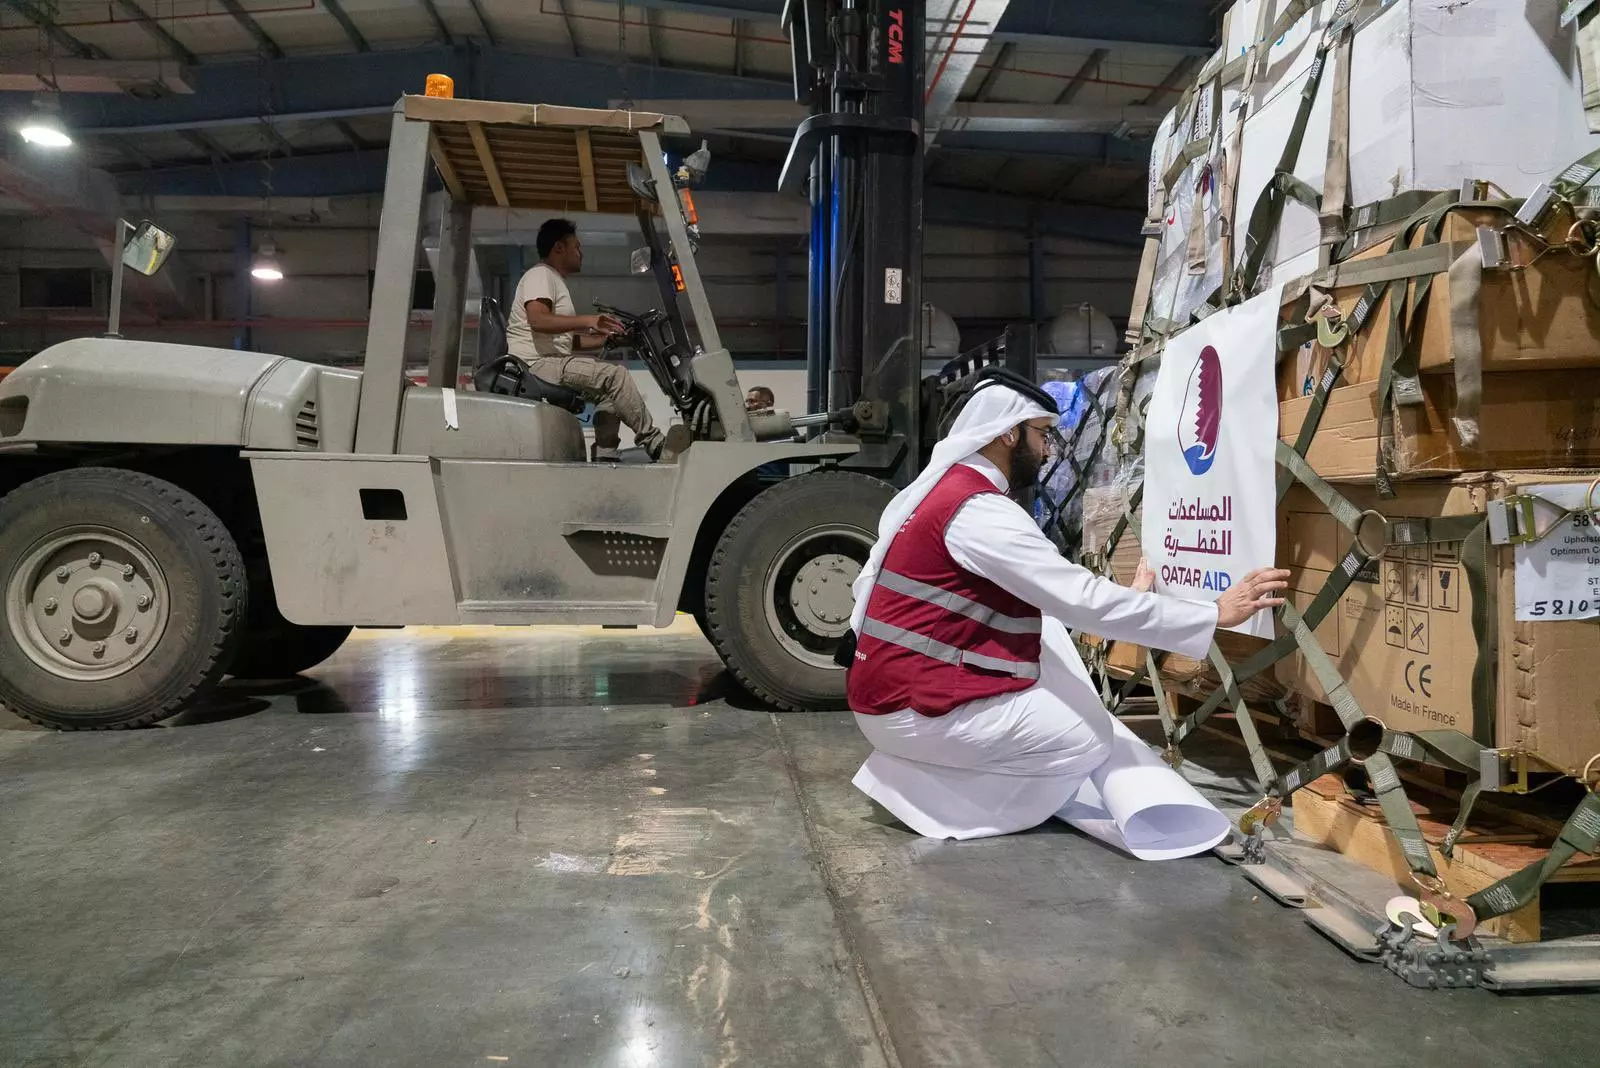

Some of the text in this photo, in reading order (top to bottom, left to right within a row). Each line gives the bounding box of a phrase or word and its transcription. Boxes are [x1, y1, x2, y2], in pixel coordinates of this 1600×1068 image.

[889, 8, 903, 63] TCM
[1168, 496, 1231, 521] المساعدات
[1164, 528, 1231, 557] القطرية
[1550, 545, 1600, 556] Optimum C
[1405, 660, 1431, 698] CE
[1390, 693, 1411, 713] Made
[1422, 705, 1456, 726] France
